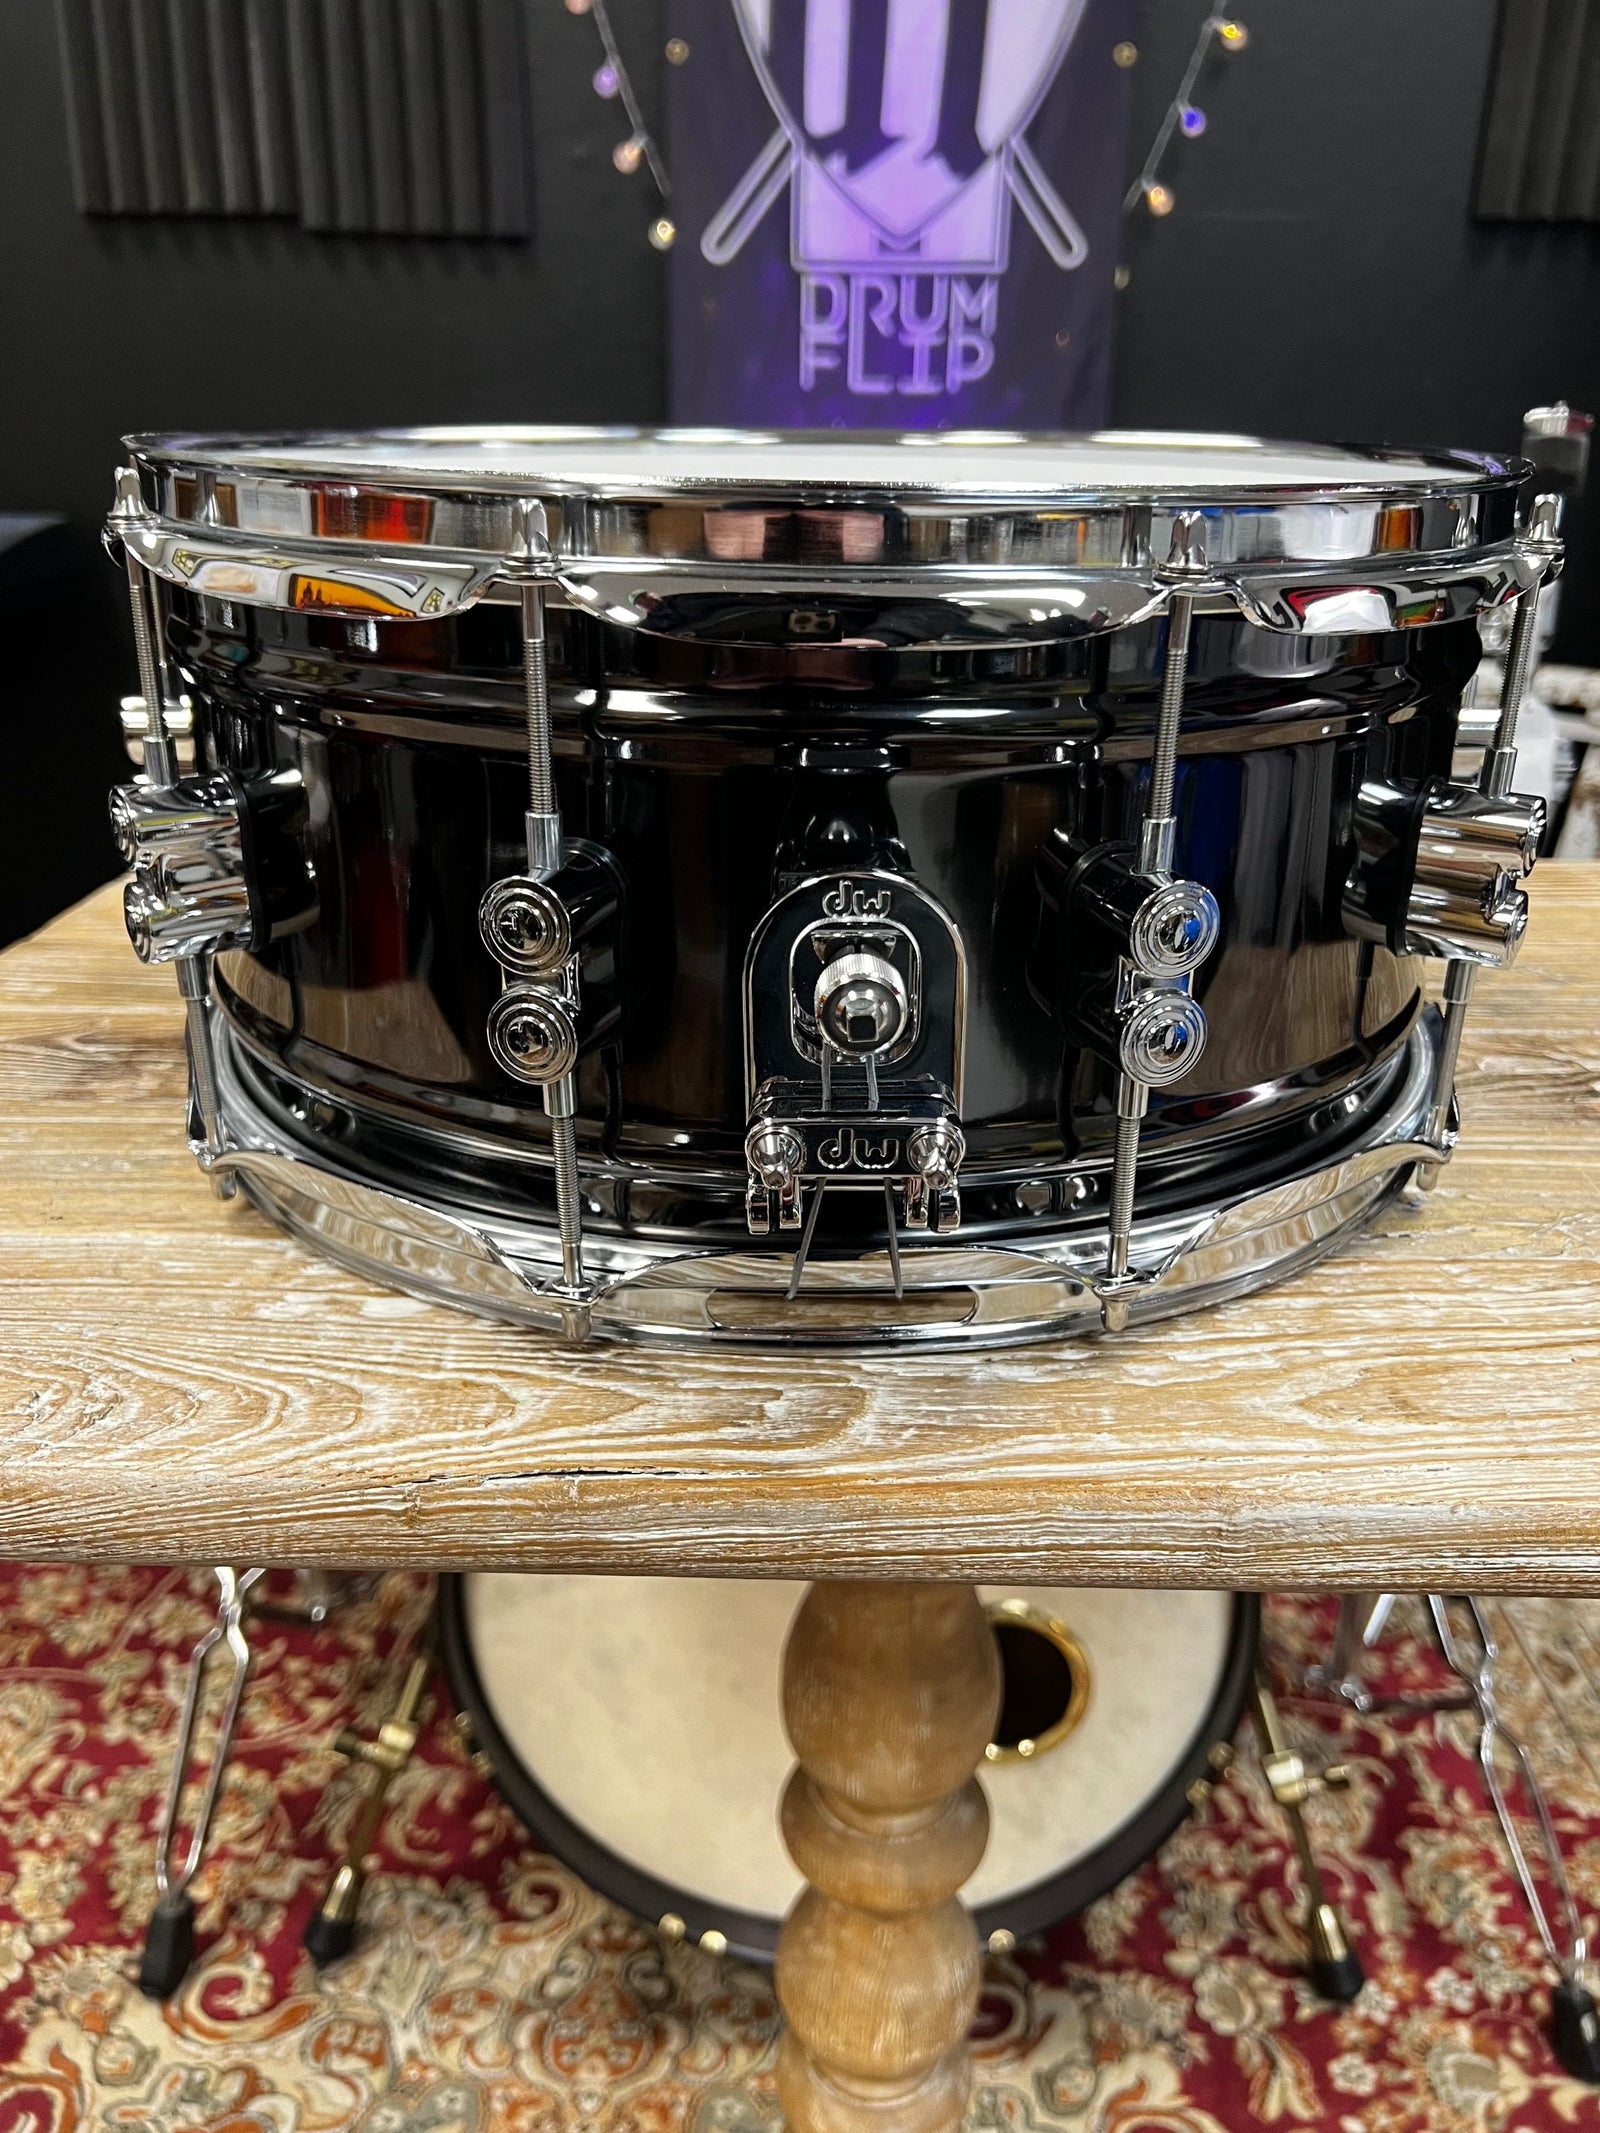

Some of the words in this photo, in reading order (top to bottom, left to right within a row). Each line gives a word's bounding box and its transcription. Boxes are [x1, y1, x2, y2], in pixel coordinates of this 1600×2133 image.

[800, 274, 999, 337] DRUM
[799, 331, 995, 394] FLIP
[822, 880, 892, 919] dw
[817, 1128, 899, 1169] dw
